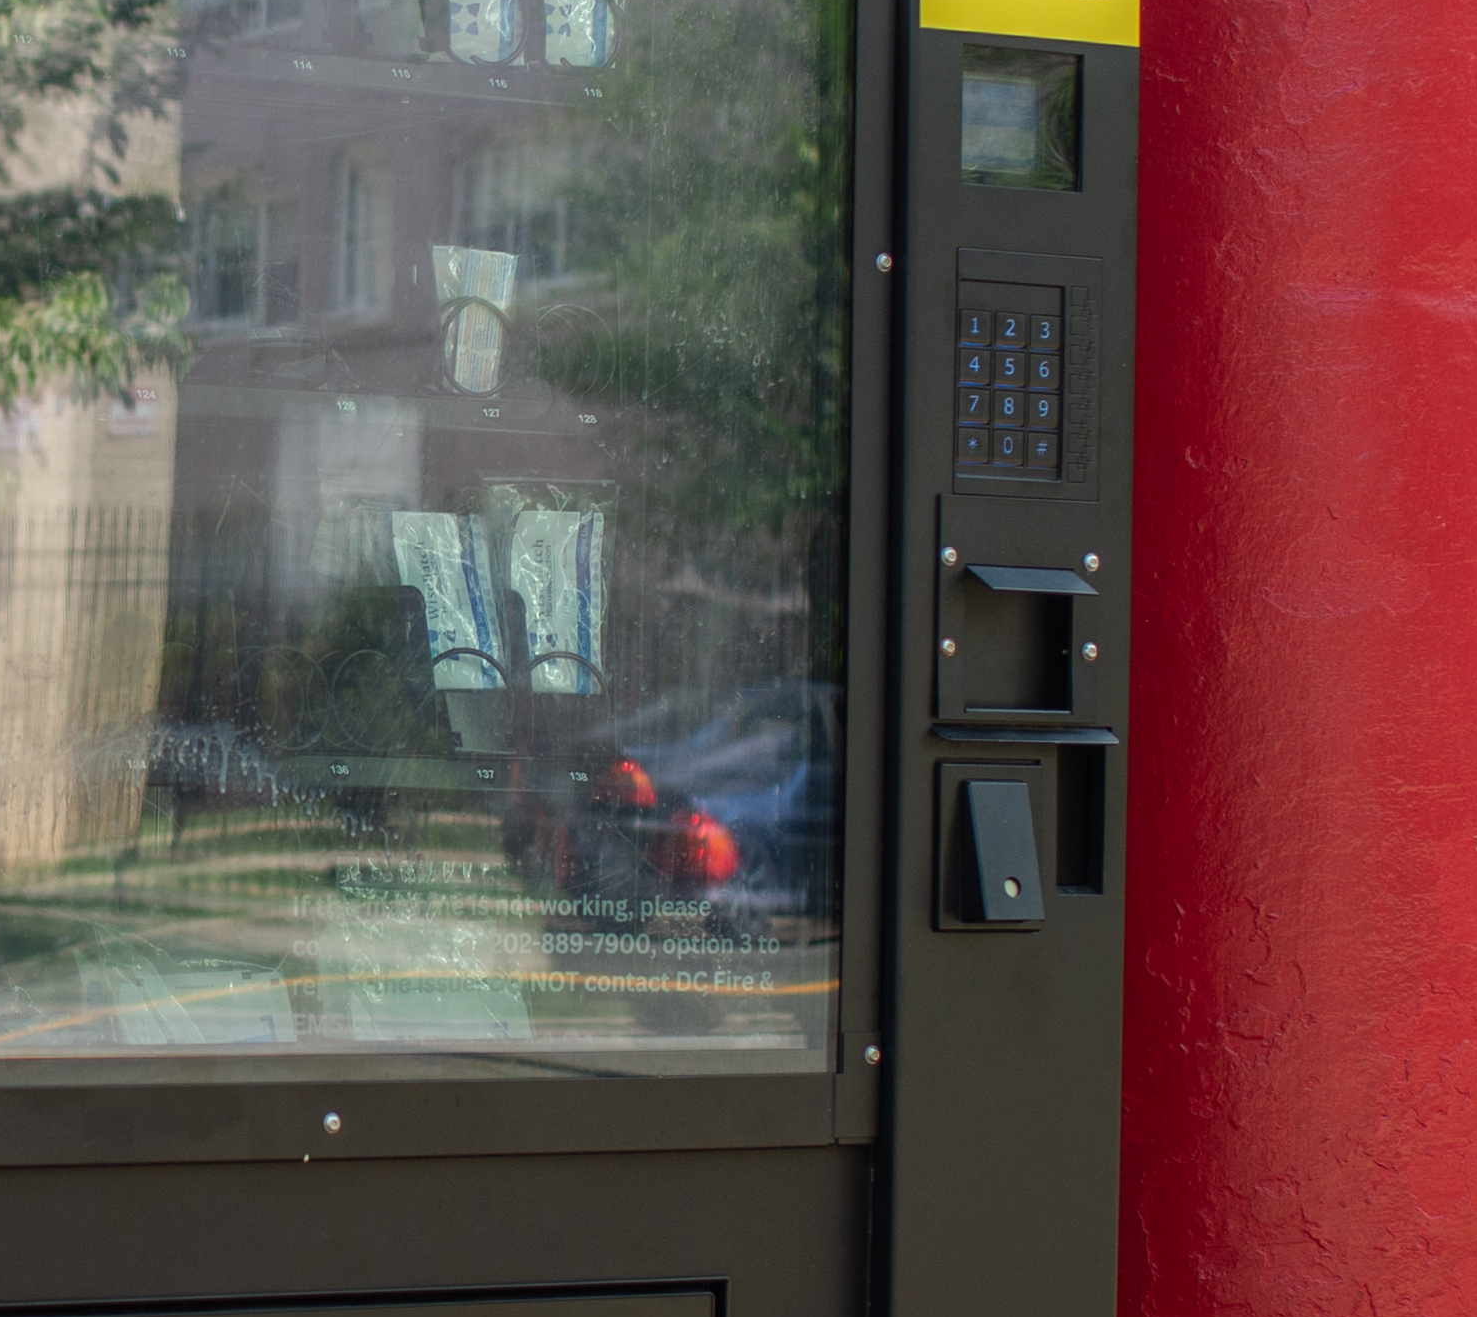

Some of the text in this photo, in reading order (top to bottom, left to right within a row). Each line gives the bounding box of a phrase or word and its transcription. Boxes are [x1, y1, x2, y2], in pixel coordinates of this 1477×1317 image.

[971, 317, 1050, 339] 1 2 3
[969, 356, 1050, 378] 4 5 6
[969, 395, 1049, 417] 7 8 9
[1003, 436, 1014, 454] 0
[495, 894, 712, 923] not working, please
[491, 932, 781, 959] 202-889-7900, option 3 to
[530, 970, 755, 993] NOT contact DC Fire
